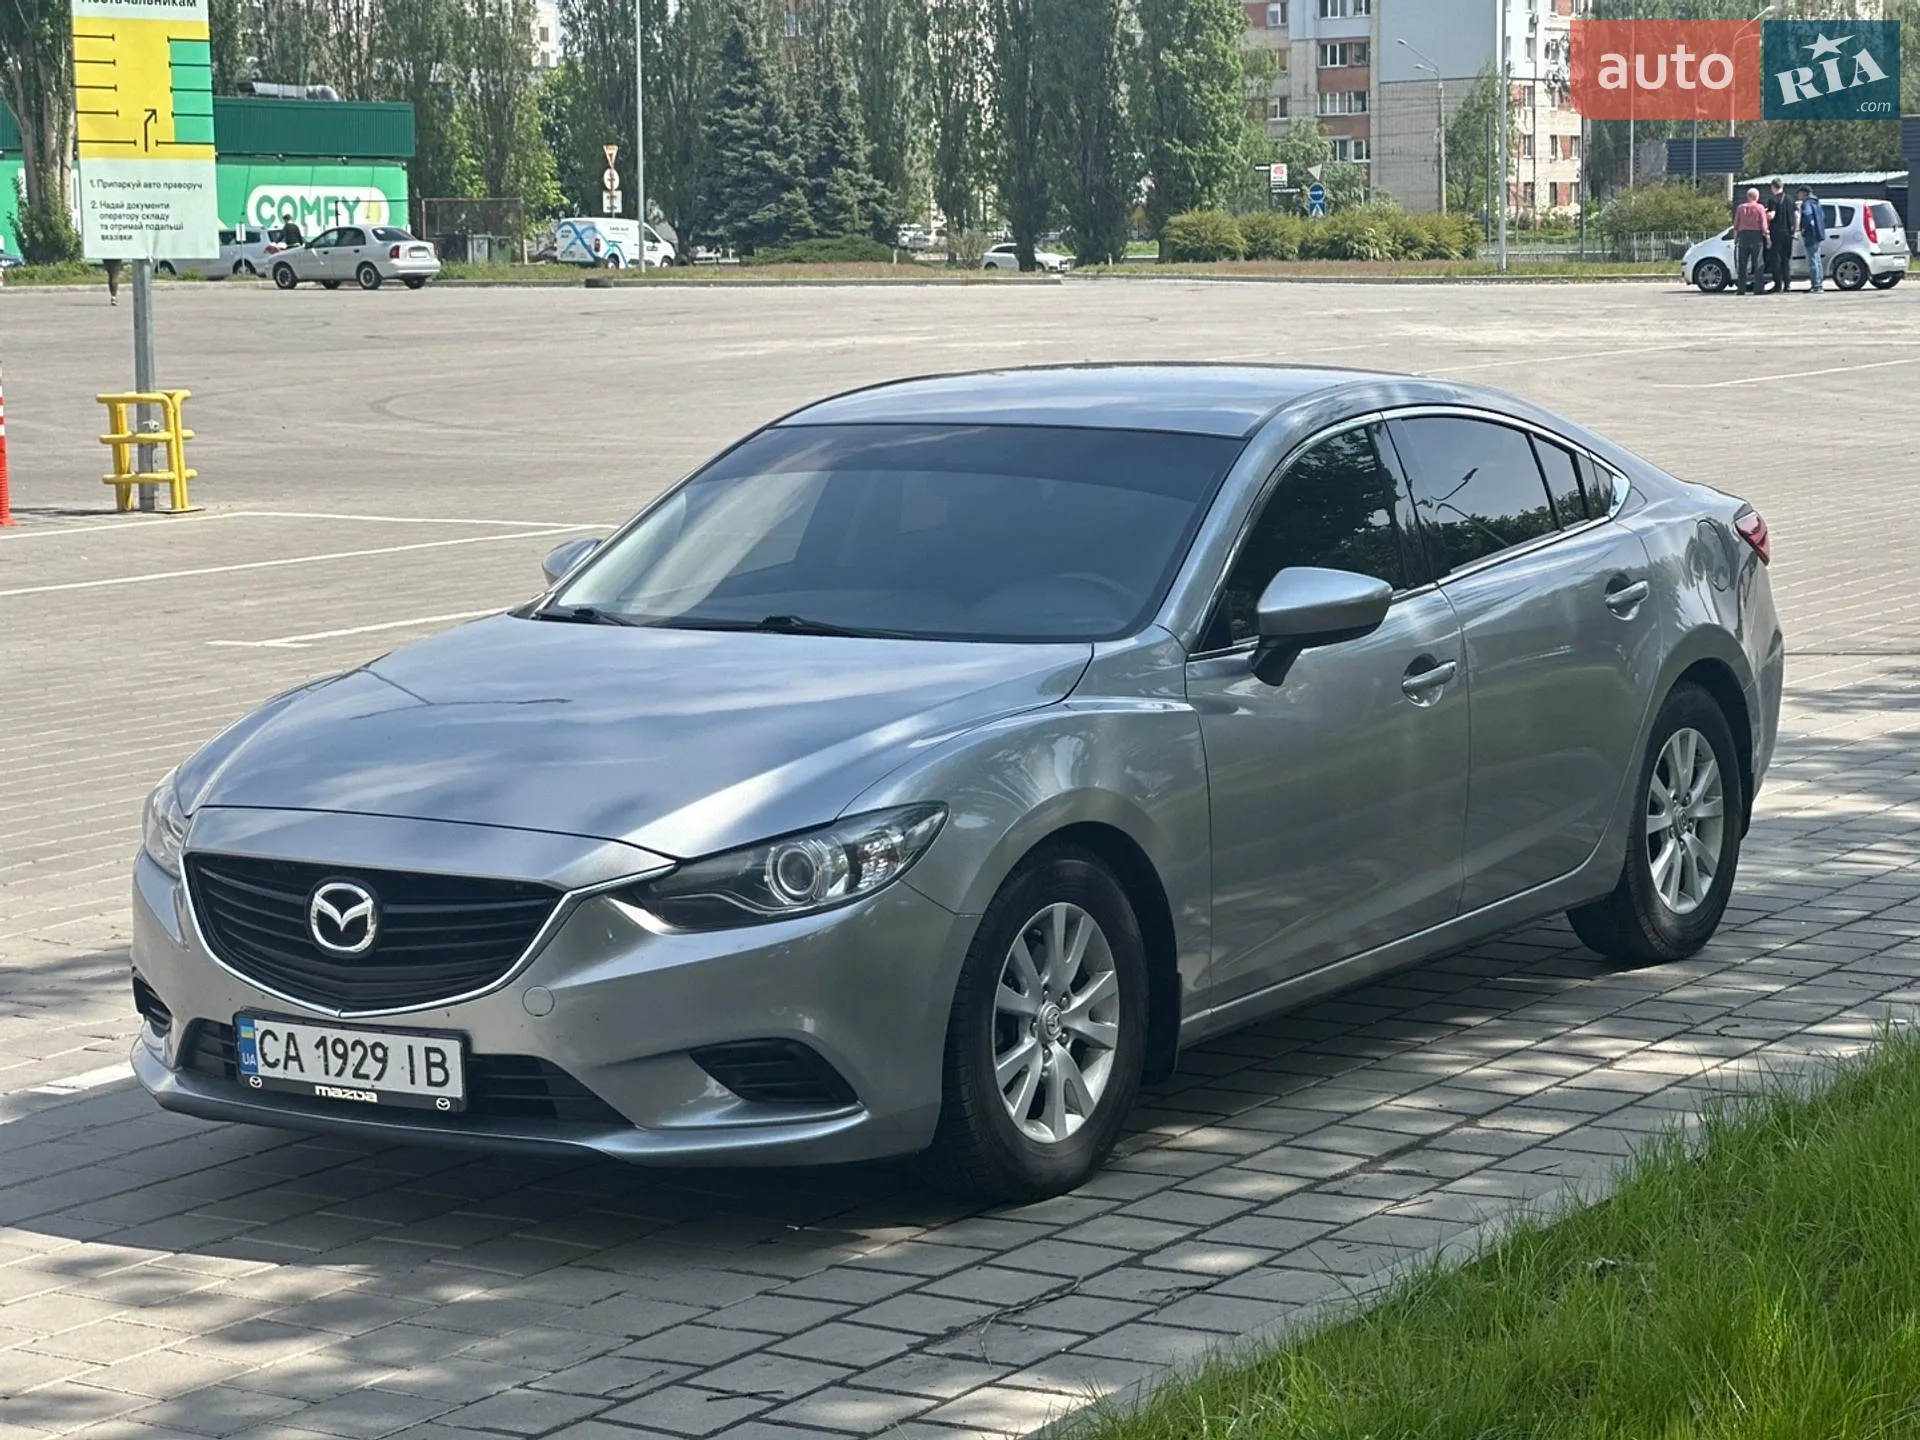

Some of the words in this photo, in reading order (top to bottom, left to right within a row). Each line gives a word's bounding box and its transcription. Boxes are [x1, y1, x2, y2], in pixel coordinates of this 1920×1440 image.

[97, 179, 142, 190] Припаркуй
[143, 181, 162, 189] авто
[163, 181, 203, 191] праворуч
[90, 200, 98, 209] 2.
[99, 200, 125, 210] Надай
[126, 202, 170, 211] документи
[256, 194, 361, 228] COMFY
[99, 213, 139, 221] оператору
[141, 213, 170, 222] складу
[110, 222, 144, 231] отримай
[145, 222, 184, 231] подальші
[242, 1052, 256, 1066] UA
[258, 1029, 305, 1073] CA
[314, 1035, 389, 1082] 1929
[407, 1044, 450, 1088] IB
[314, 1085, 379, 1103] mazda
